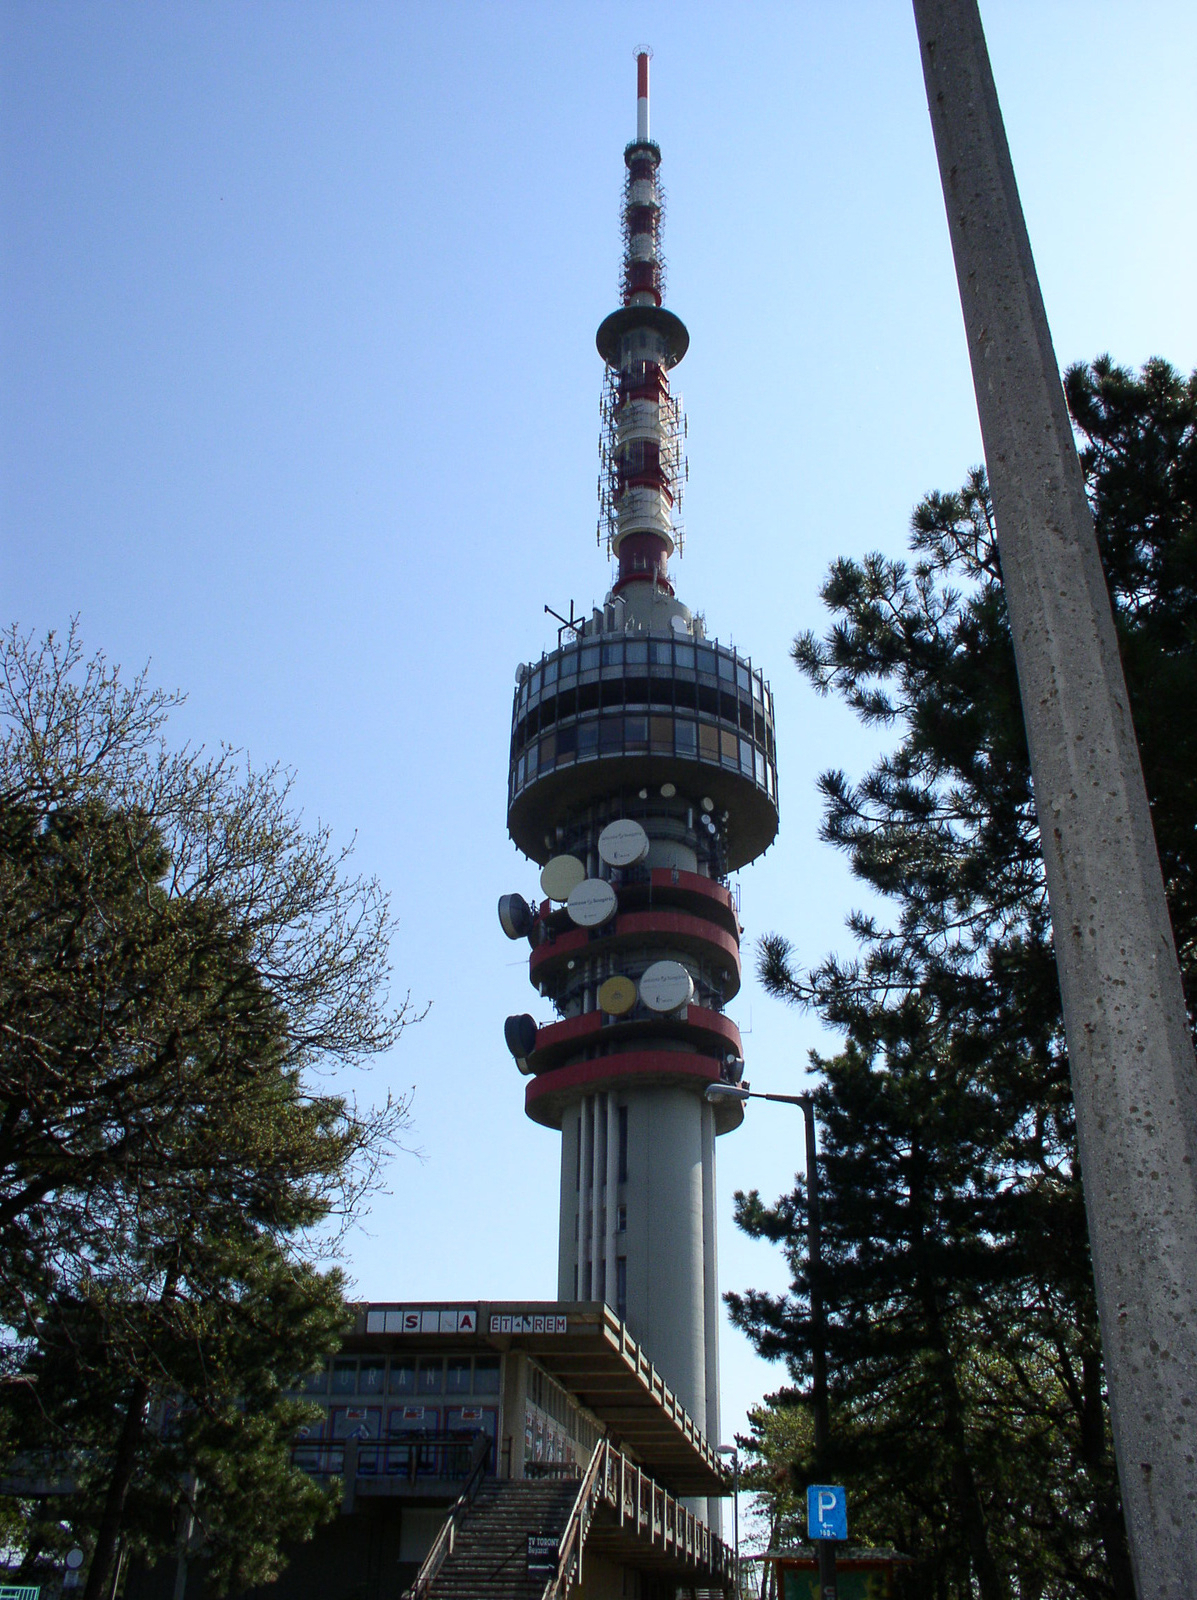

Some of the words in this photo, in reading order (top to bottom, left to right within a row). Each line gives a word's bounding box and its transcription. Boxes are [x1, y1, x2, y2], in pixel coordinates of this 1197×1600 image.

[818, 1491, 837, 1523] P
[528, 1537, 536, 1546] TV
[536, 1537, 560, 1547] TORONY
